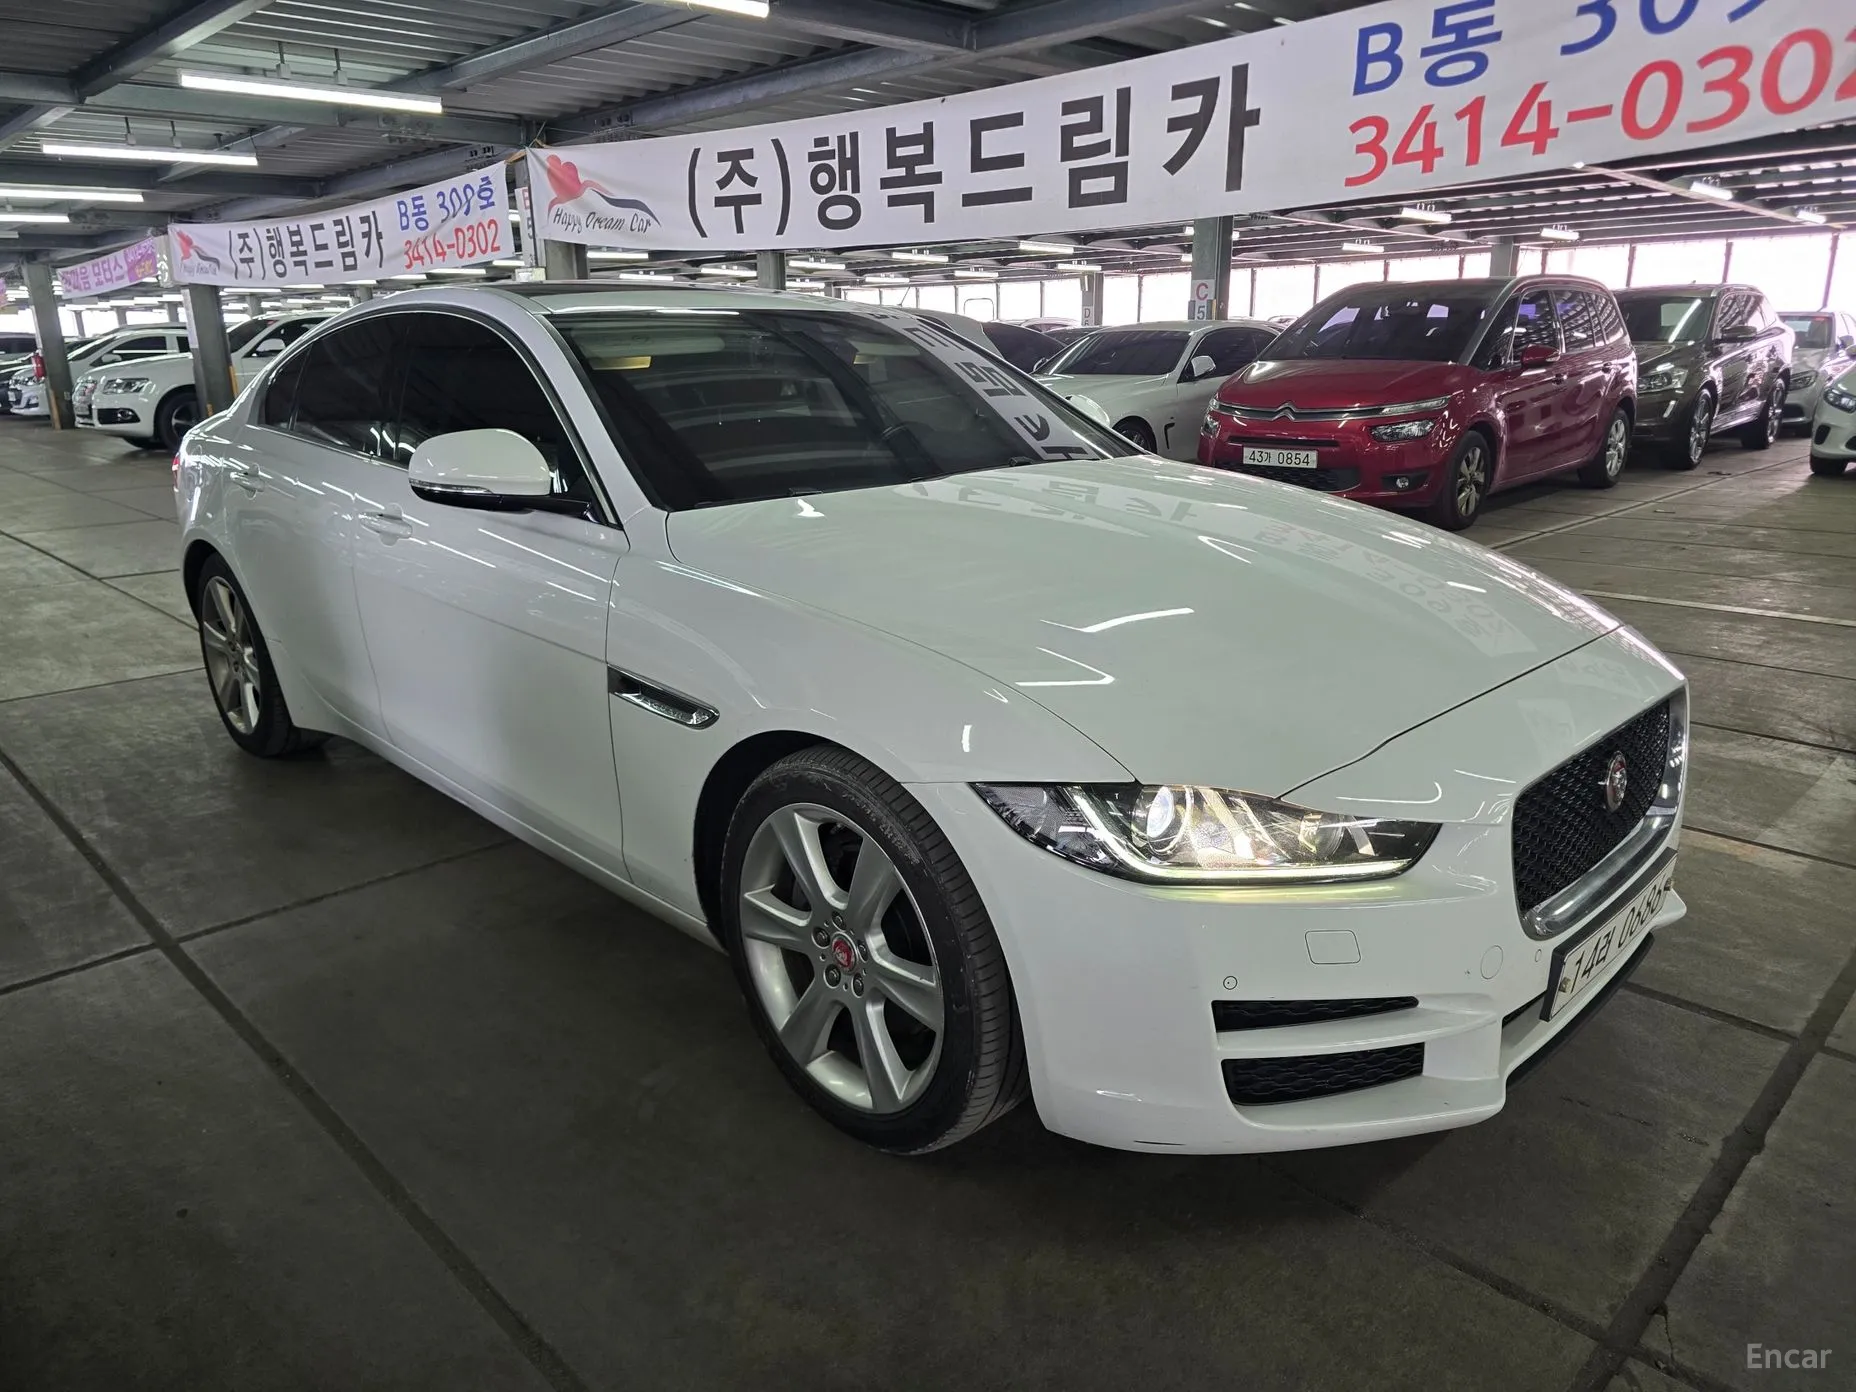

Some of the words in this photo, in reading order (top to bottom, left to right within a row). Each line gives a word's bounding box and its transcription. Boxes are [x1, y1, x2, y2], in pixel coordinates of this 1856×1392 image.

[1353, 0, 1503, 96] B동
[687, 62, 1261, 239] (주)행복드림카
[397, 195, 429, 232] B동
[436, 176, 495, 223] 309호
[553, 207, 582, 234] Happy
[585, 211, 625, 231] Dream
[630, 212, 651, 233] Car
[229, 211, 383, 281] (주)행복드림카
[404, 218, 501, 270] 3414-0302
[92, 256, 126, 287] 모터스
[1195, 282, 1209, 301] C
[1084, 308, 1091, 318] D
[1196, 305, 1206, 320] 5
[1249, 450, 1271, 463] 43가
[1277, 452, 1310, 466] 0854
[1617, 874, 1666, 949] 0686
